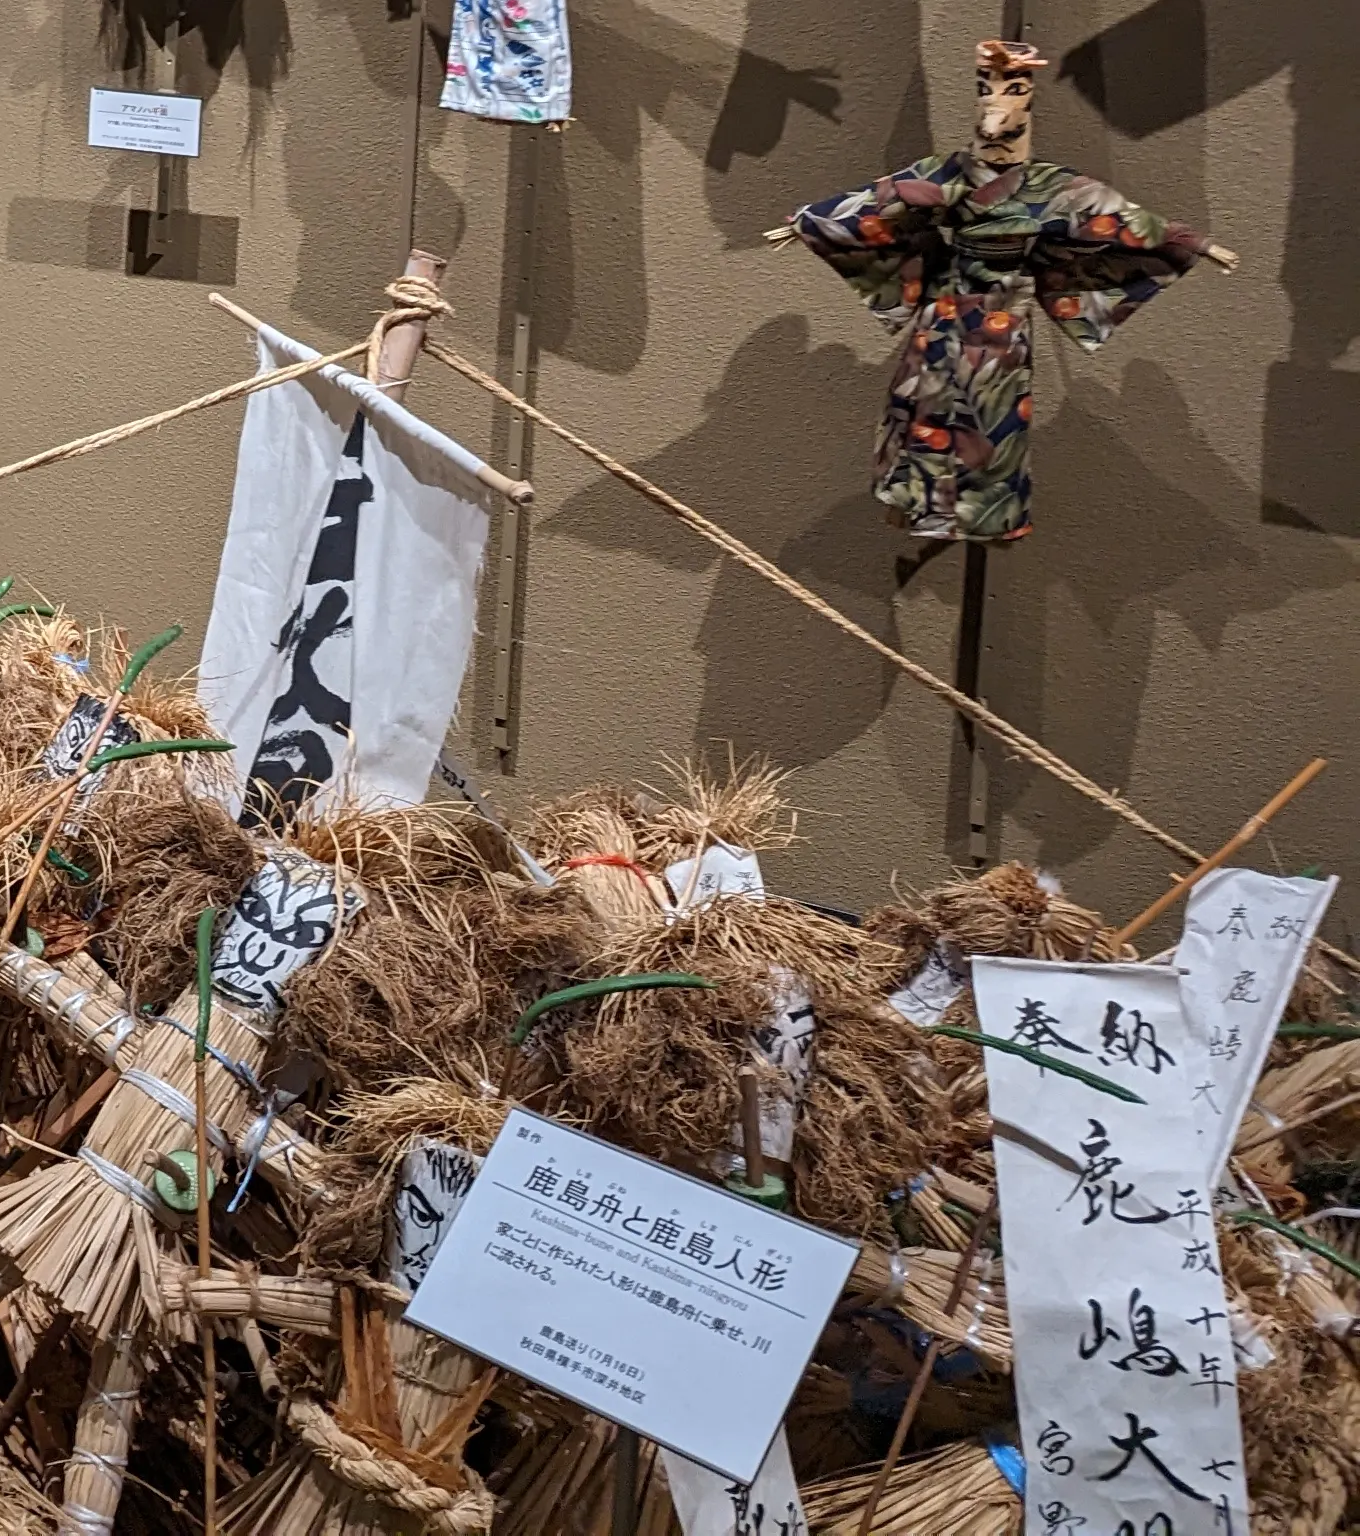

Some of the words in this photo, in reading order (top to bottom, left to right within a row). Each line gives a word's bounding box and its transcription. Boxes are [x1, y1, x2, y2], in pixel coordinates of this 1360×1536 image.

[1009, 997, 1177, 1078] 奉納
[516, 1126, 544, 1145] 製作
[523, 1164, 788, 1292] 鹿島舟と鹿島人形
[615, 1246, 640, 1264] and
[483, 1241, 557, 1286] に流される。
[495, 1221, 772, 1354] 家ごとに作られた人形は鹿島舟に乗せ、川
